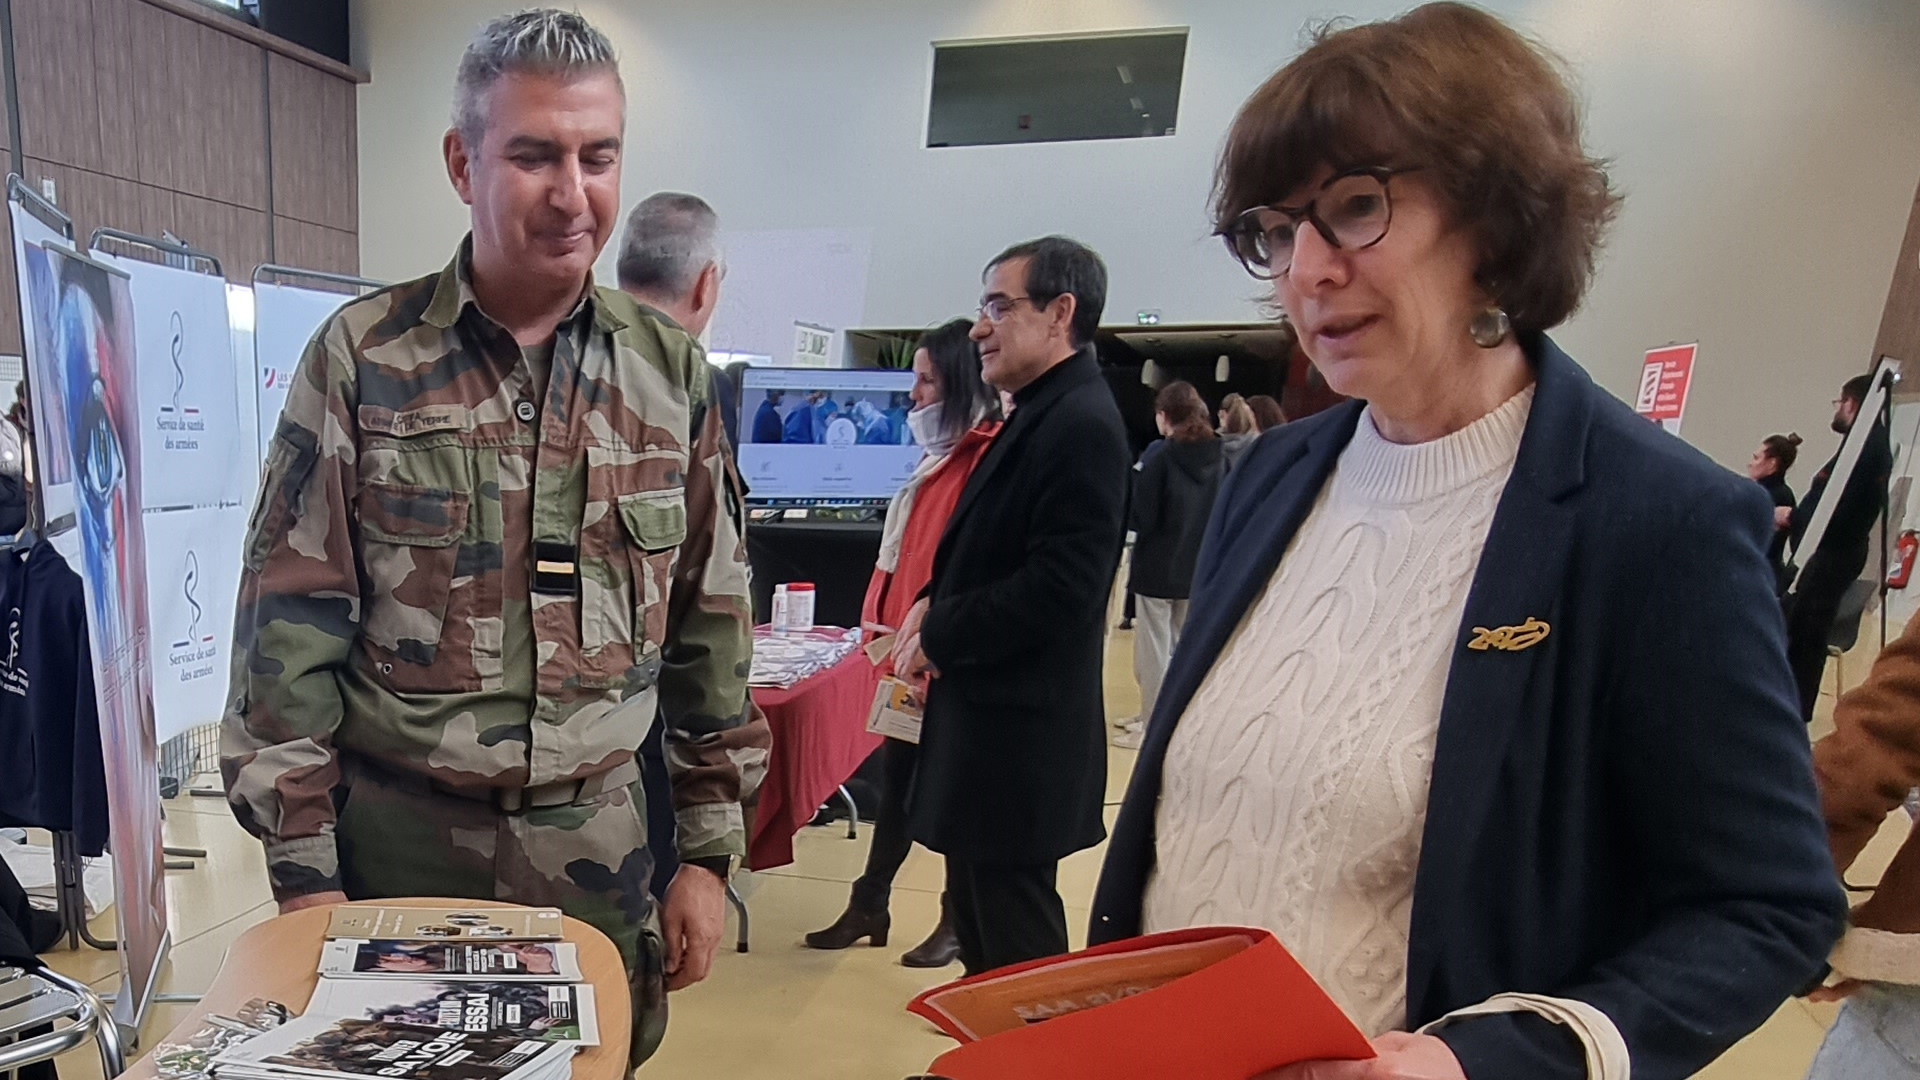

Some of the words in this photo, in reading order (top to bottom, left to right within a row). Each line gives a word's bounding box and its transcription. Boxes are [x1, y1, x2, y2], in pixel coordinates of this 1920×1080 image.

[156, 416, 178, 431] Service
[178, 416, 186, 431] de
[164, 435, 175, 449] des
[168, 651, 196, 666] Service
[196, 646, 204, 660] de
[180, 668, 192, 682] des
[464, 993, 489, 1032] ESSAI
